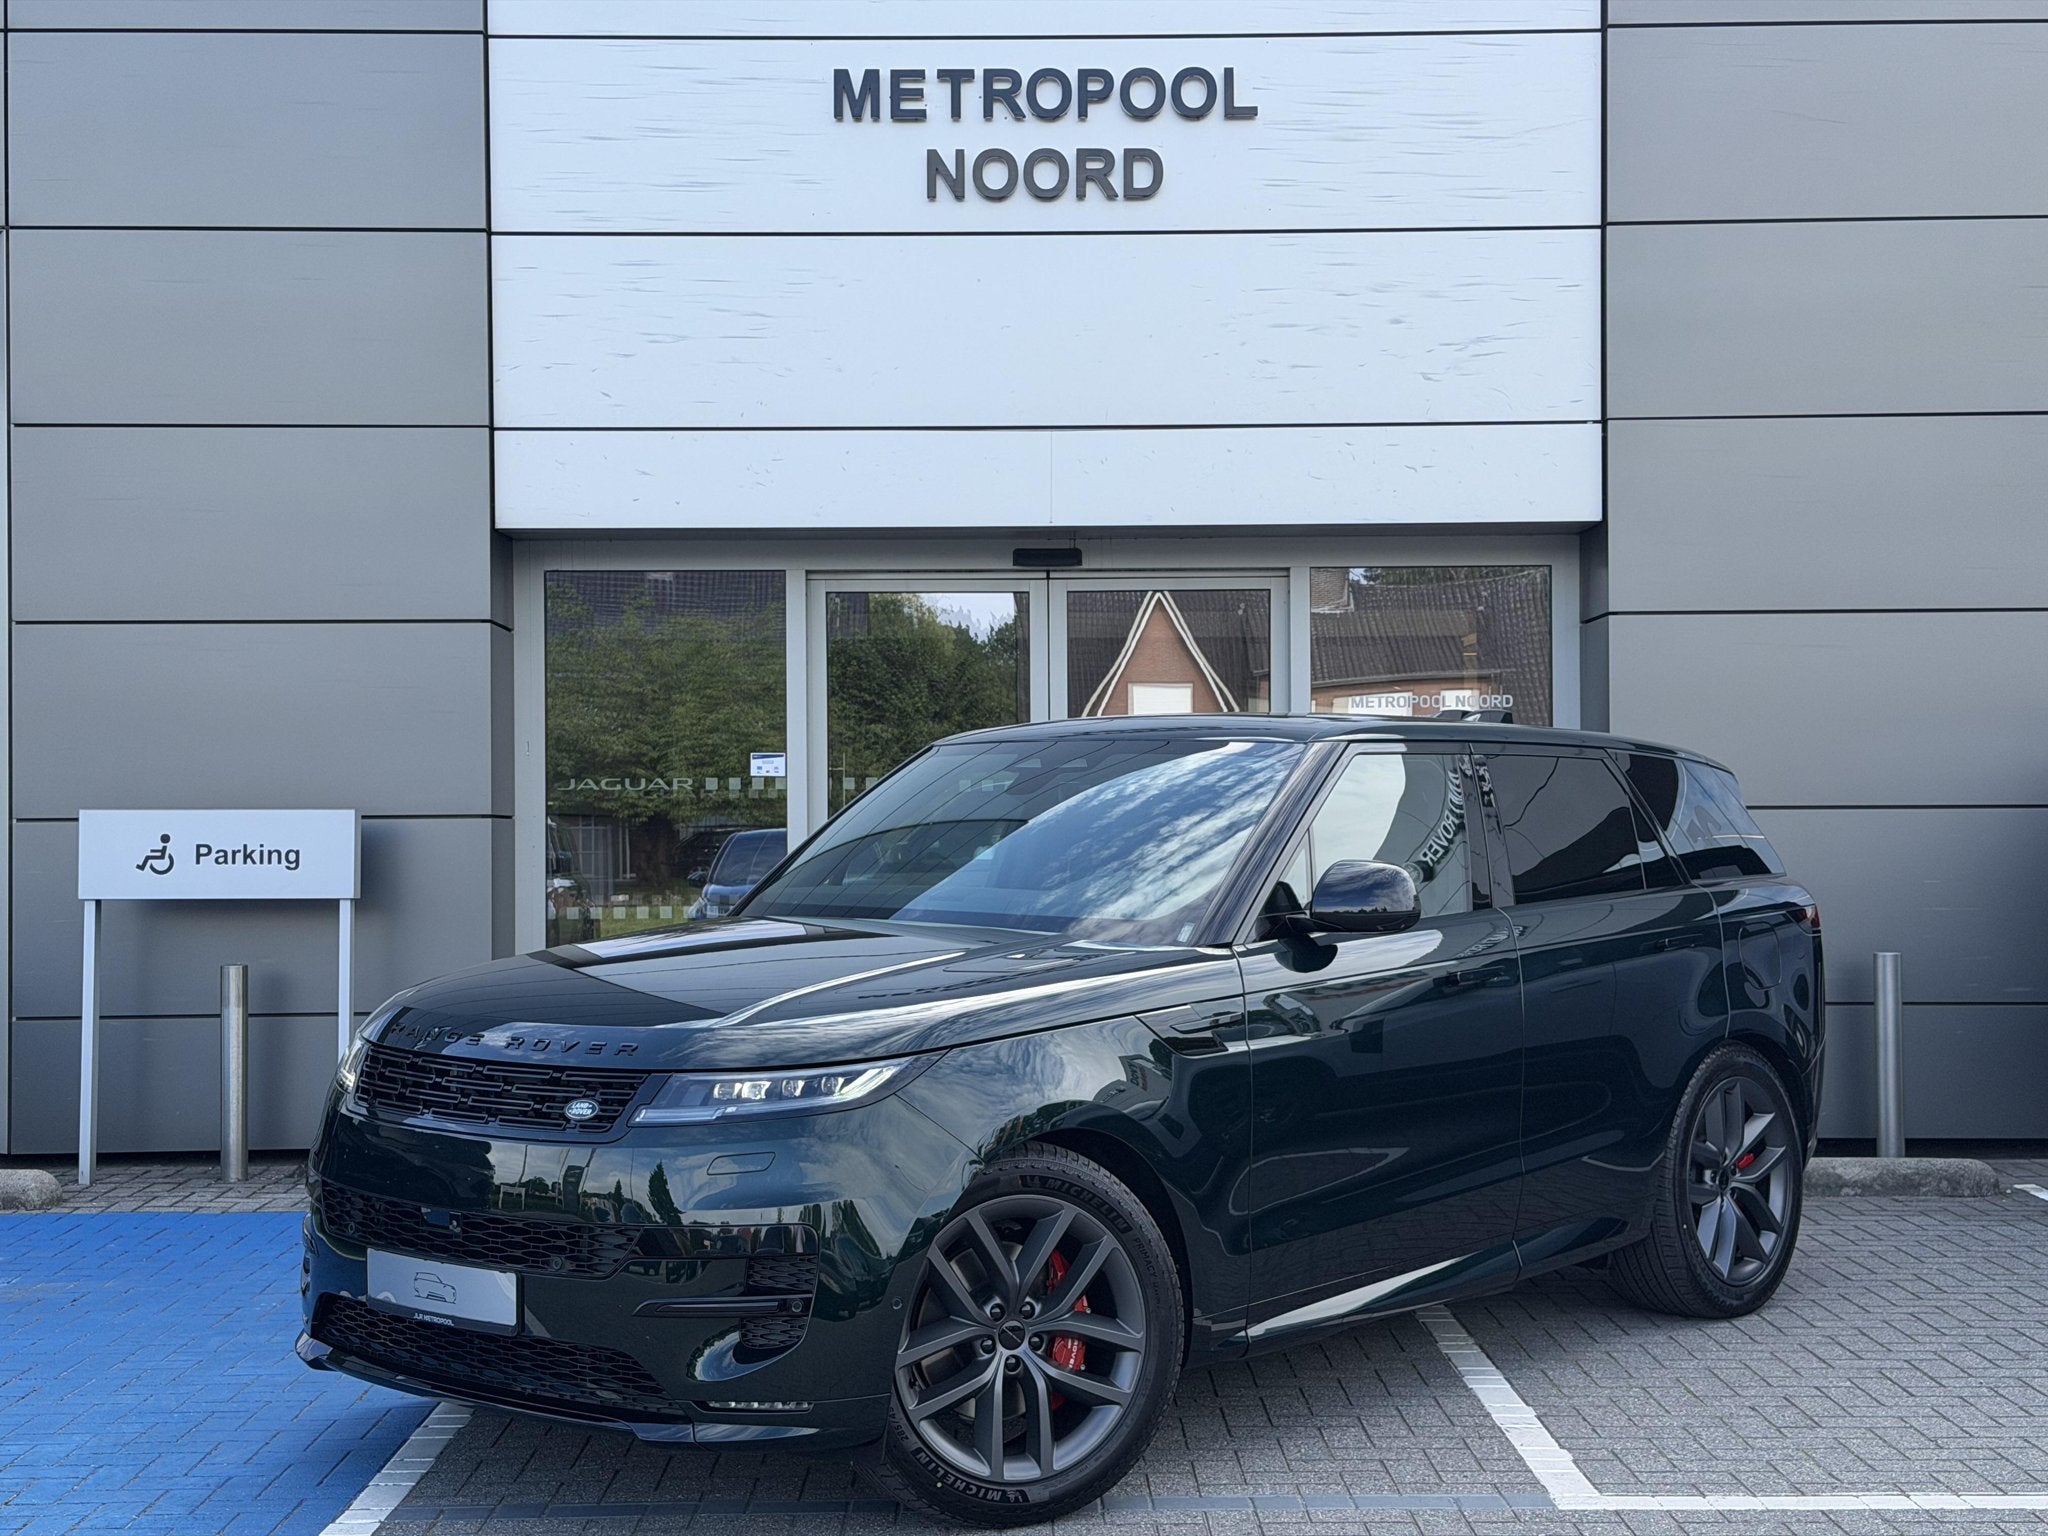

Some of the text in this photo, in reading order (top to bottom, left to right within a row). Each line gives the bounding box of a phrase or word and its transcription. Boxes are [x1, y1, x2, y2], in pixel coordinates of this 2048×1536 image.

[832, 66, 1259, 122] METROPOOL
[926, 147, 1164, 202] NOORD
[1351, 694, 1514, 709] METROPOOL NOORD
[557, 777, 694, 791] JAGUAR
[194, 843, 301, 871] Parking
[390, 1022, 639, 1057] RANGE ROVER
[1045, 1178, 1128, 1233] MICHELIN
[915, 1452, 1003, 1501] MICHELIN
